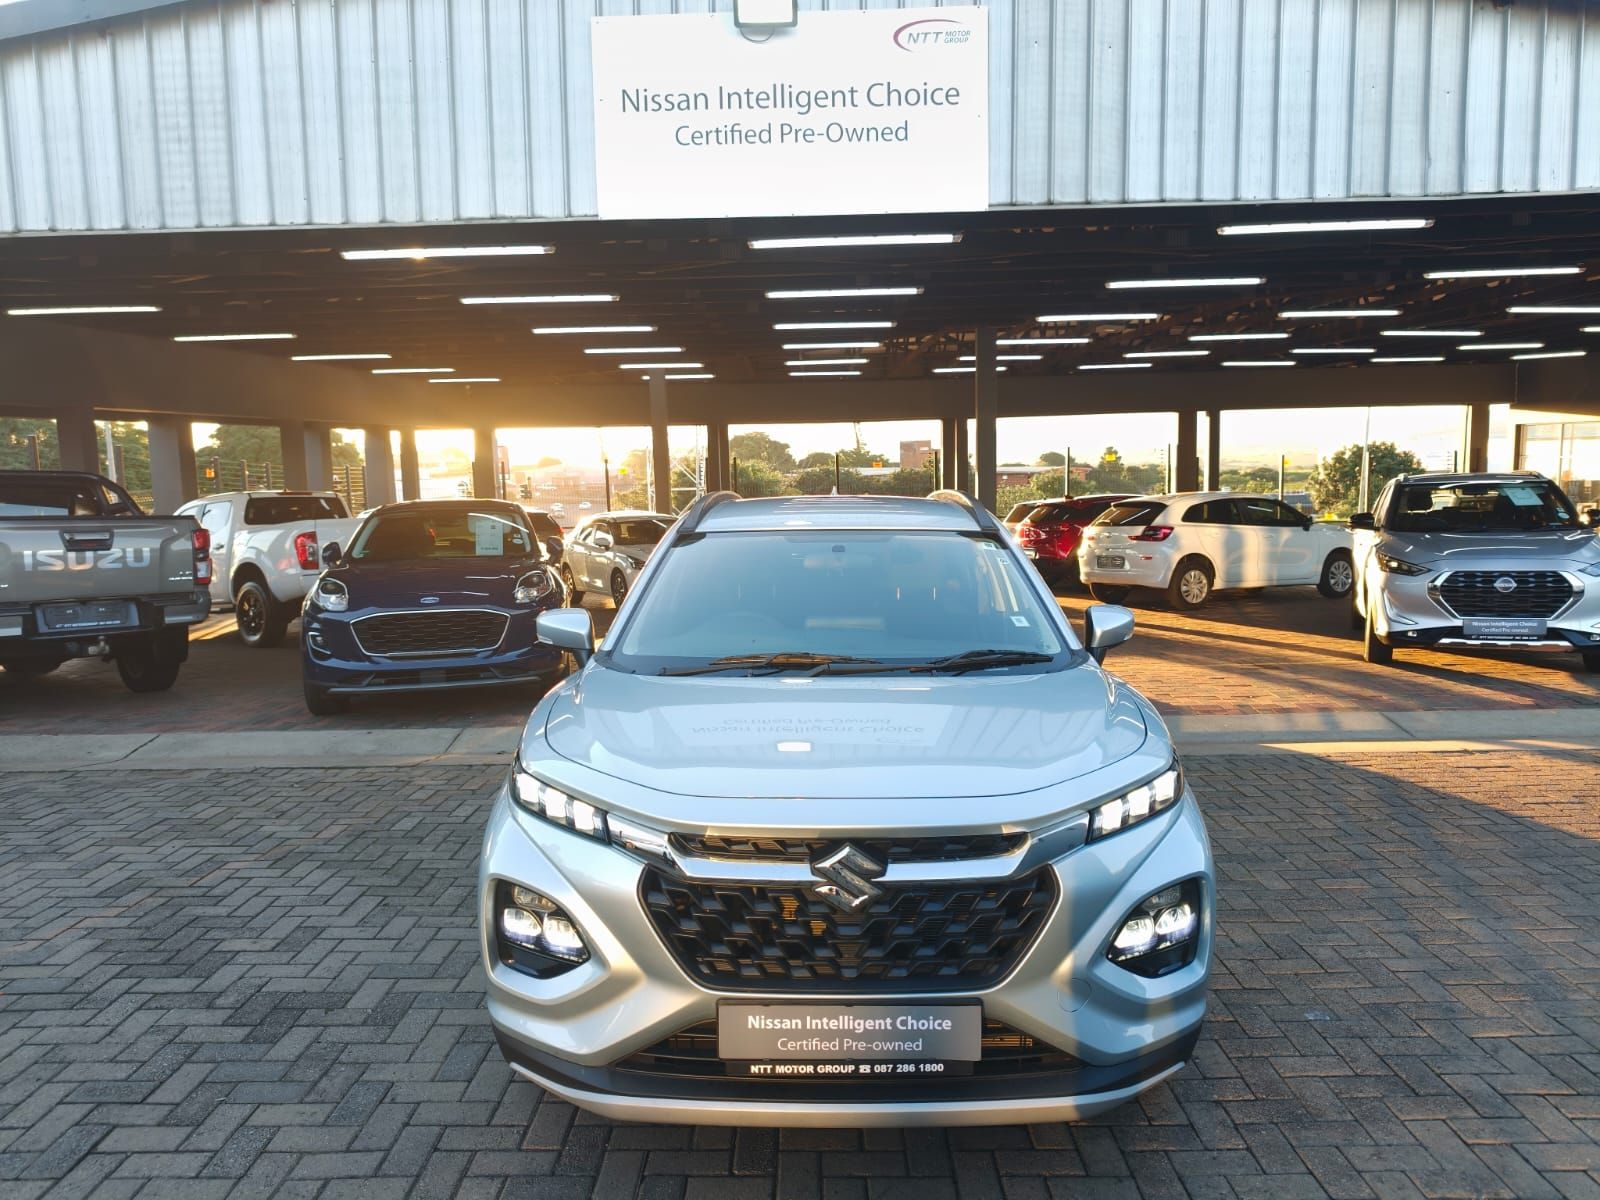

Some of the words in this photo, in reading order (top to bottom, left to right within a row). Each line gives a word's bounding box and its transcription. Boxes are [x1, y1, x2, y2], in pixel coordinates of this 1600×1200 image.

[907, 31, 942, 45] NTT
[943, 36, 969, 44] GROUP
[944, 30, 971, 38] MOTOR
[621, 88, 709, 113] Nissan
[718, 83, 859, 115] Intelligent
[866, 81, 961, 107] Choice
[675, 123, 772, 146] Certified
[779, 120, 909, 143] Pre-Owned
[23, 547, 150, 572] ISUZU
[747, 1015, 802, 1030] Nissan
[806, 1015, 893, 1033] Intelligent
[895, 1016, 952, 1031] Choice
[777, 1037, 839, 1051] Certified
[843, 1038, 922, 1052] Pre-owned
[750, 1064, 773, 1074] NTT
[775, 1064, 814, 1074] MOTOR
[817, 1064, 855, 1074] GROUP
[873, 1064, 893, 1073] 087
[896, 1063, 916, 1073] 286
[918, 1063, 944, 1072] 1800
